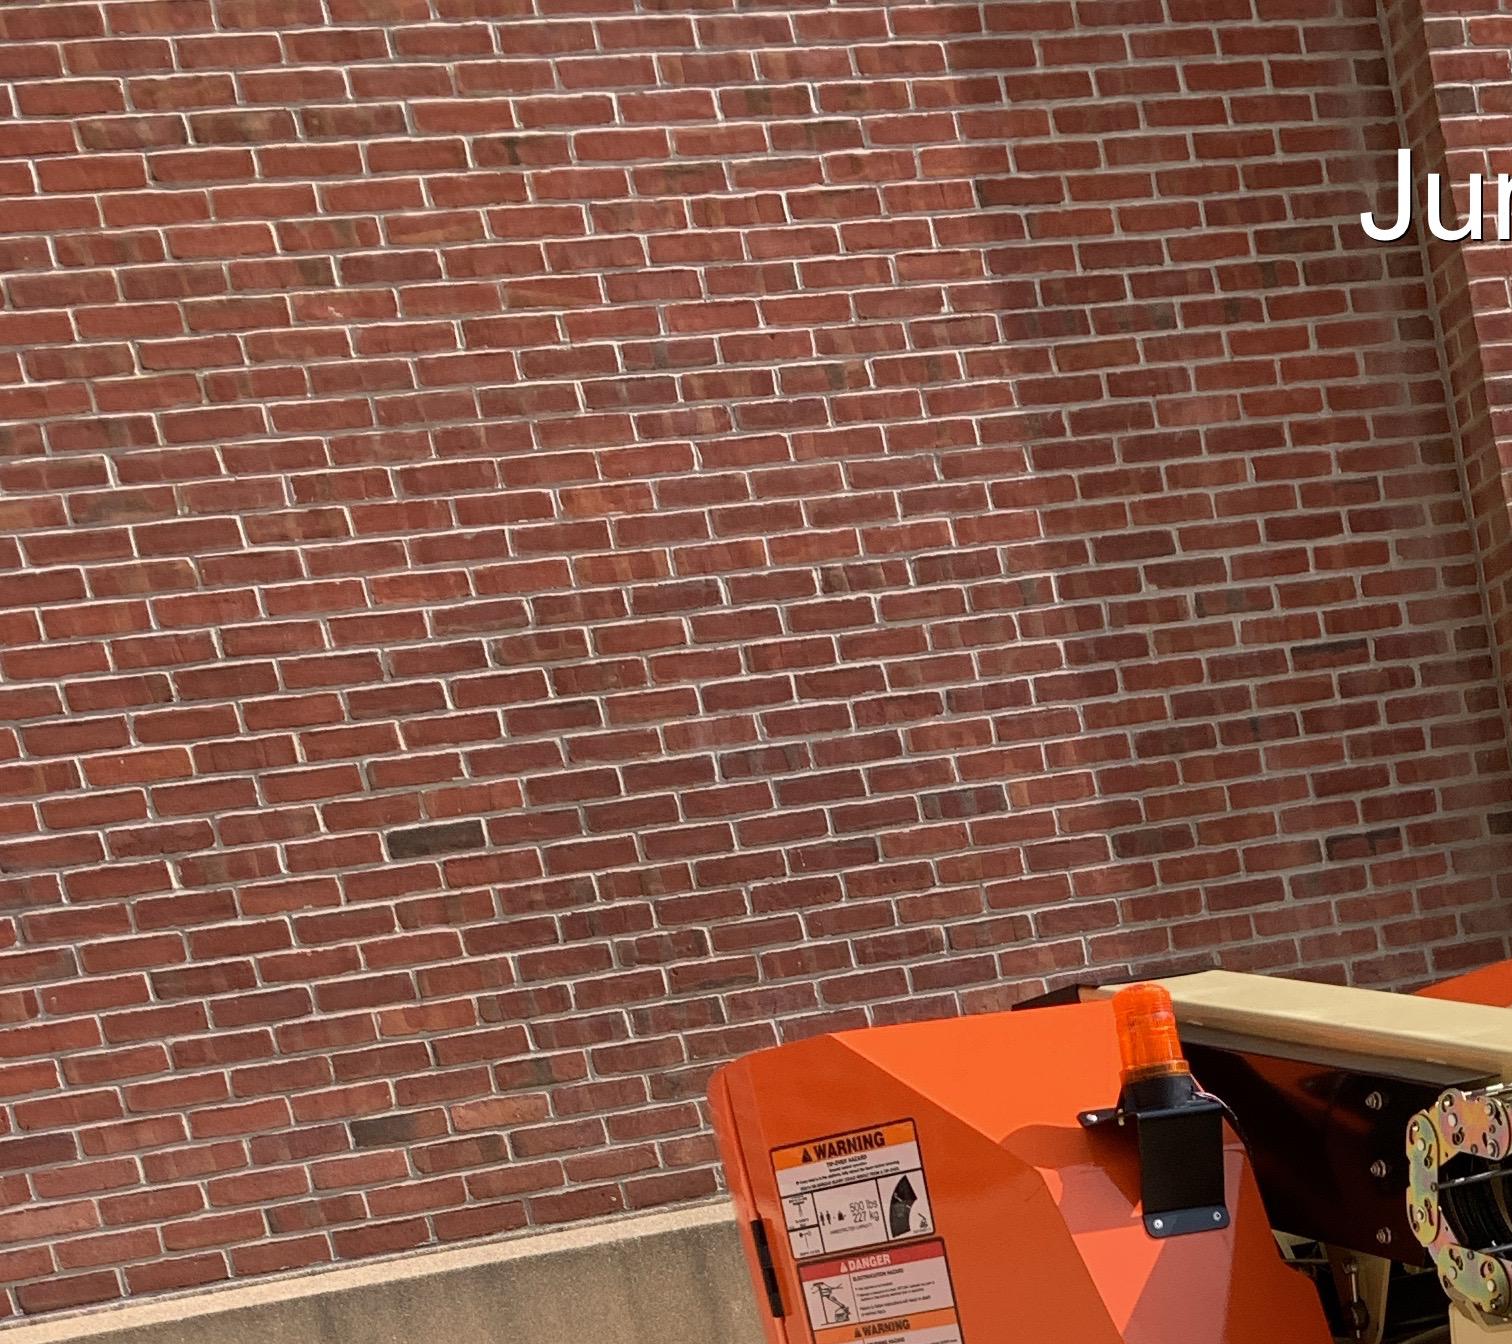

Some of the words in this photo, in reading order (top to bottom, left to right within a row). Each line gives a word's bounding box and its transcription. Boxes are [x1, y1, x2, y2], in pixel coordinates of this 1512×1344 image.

[813, 1131, 886, 1161] WARNING
[849, 1254, 891, 1272] DANGER
[863, 1319, 910, 1337] WARNING
